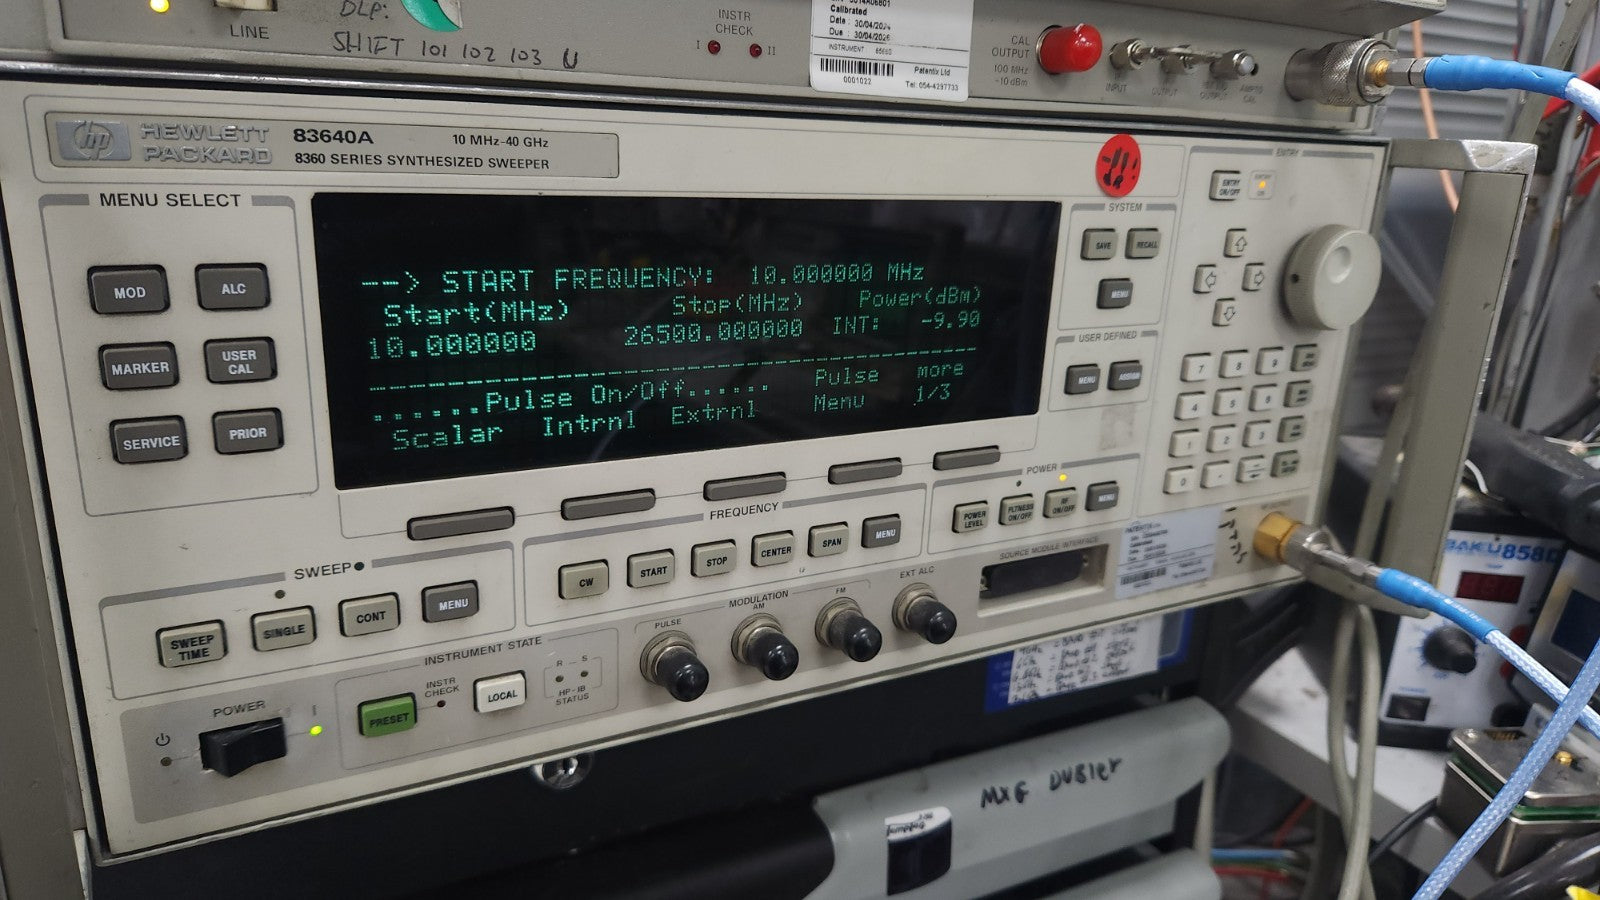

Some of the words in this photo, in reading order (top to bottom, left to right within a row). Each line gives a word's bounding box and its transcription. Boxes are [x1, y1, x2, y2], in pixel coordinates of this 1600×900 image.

[718, 9, 751, 21] INSTR
[830, 4, 868, 16] Calibrated
[830, 15, 846, 24] Date
[230, 24, 270, 40] LINE
[715, 23, 753, 36] CHECK
[829, 27, 844, 36] Due
[1011, 35, 1030, 46] CAL
[333, 31, 404, 57] SHIFT
[421, 40, 447, 58] 101
[462, 43, 496, 63] 102
[510, 48, 542, 66] 103
[829, 43, 865, 54] INSTRUMENT
[991, 48, 1030, 59] OUTPUT
[914, 66, 939, 76] Patentix
[993, 65, 1010, 74] 100
[1011, 65, 1028, 75] MHz
[843, 76, 872, 86] 0001022
[1105, 84, 1127, 94] INPUT
[140, 123, 270, 143] HEWLETT
[293, 129, 374, 145] 83640A
[452, 134, 467, 146] 10
[523, 136, 549, 148] GHz
[143, 145, 273, 165] PACKARD
[295, 153, 326, 165] 8360
[330, 153, 382, 166] SERIES
[387, 155, 483, 169] SYNTHESIZED
[487, 157, 550, 170] SWEEPER
[100, 192, 159, 207] MENU
[165, 193, 241, 208] SELECT
[1108, 202, 1143, 213] SYSTEM
[1096, 241, 1112, 250] SAVE
[1136, 240, 1158, 250] RECALL
[442, 269, 535, 293] START
[554, 266, 713, 290] FREQUENCY:
[751, 263, 874, 285] 10.000000
[887, 262, 925, 282] MHz
[114, 286, 146, 299] MOD
[222, 283, 246, 295] ALC
[1111, 289, 1129, 299] MENU
[384, 299, 569, 327] Start(MHz)
[672, 292, 803, 316] Stop(MHz)
[858, 286, 982, 308] Power(dBm)
[369, 330, 537, 360] 10.000000
[624, 318, 803, 346] 26500.000000
[833, 316, 880, 335] INT:
[921, 310, 981, 330] -9.90
[1079, 332, 1101, 343] USER
[1103, 330, 1137, 342] DEFINED
[222, 350, 257, 362] USER
[112, 362, 170, 376] MARKER
[228, 363, 254, 375] CAL
[815, 367, 880, 387] Pulse
[917, 363, 965, 379] more
[1078, 375, 1096, 385] MENU
[393, 424, 503, 450] Scalar
[543, 409, 636, 437] Intrnl
[671, 400, 757, 425] Extrnl
[814, 392, 865, 412] Menu
[916, 384, 951, 403] 1/3
[229, 427, 267, 440] PRIOR
[123, 435, 181, 451] SERVICE
[1026, 463, 1058, 475] POWER
[1097, 494, 1116, 503] MENU
[709, 501, 780, 521] FREQUENCY
[1008, 503, 1034, 513] FLTNESS
[1052, 504, 1076, 515] ON/OFF
[963, 511, 986, 520] POWER
[1008, 512, 1033, 522] ON/OFF
[964, 520, 984, 529] LEVEL
[875, 528, 896, 540] MENU
[821, 537, 842, 548] SPAN
[1000, 548, 1030, 560] SOURCE
[1030, 543, 1060, 556] MODULE
[1063, 536, 1099, 550] INTERFACE
[760, 545, 792, 558] CENTER
[706, 556, 728, 568] STOP
[294, 562, 352, 581] SWEEP
[640, 565, 668, 578] START
[899, 569, 916, 579] EXT
[917, 566, 935, 577] ALC
[579, 577, 595, 589] CW
[835, 587, 847, 595] FM
[439, 597, 469, 611] MENU
[729, 589, 790, 608] MODULATION
[753, 602, 766, 611] AM
[356, 610, 386, 625] CONT
[654, 618, 682, 630] PULSE
[263, 623, 306, 641] SINGLE
[170, 634, 215, 650] SWEEP
[179, 647, 210, 662] TIME
[424, 642, 504, 667] INSTRUMENT
[507, 635, 543, 651] STATE
[556, 659, 563, 668] R
[581, 654, 588, 663] S
[426, 676, 456, 688] INSTR
[424, 684, 460, 698] CHECK
[487, 690, 518, 704] LOCAL
[555, 692, 590, 706] STATUS
[213, 700, 266, 718] POWER
[369, 712, 410, 728] PRESET
